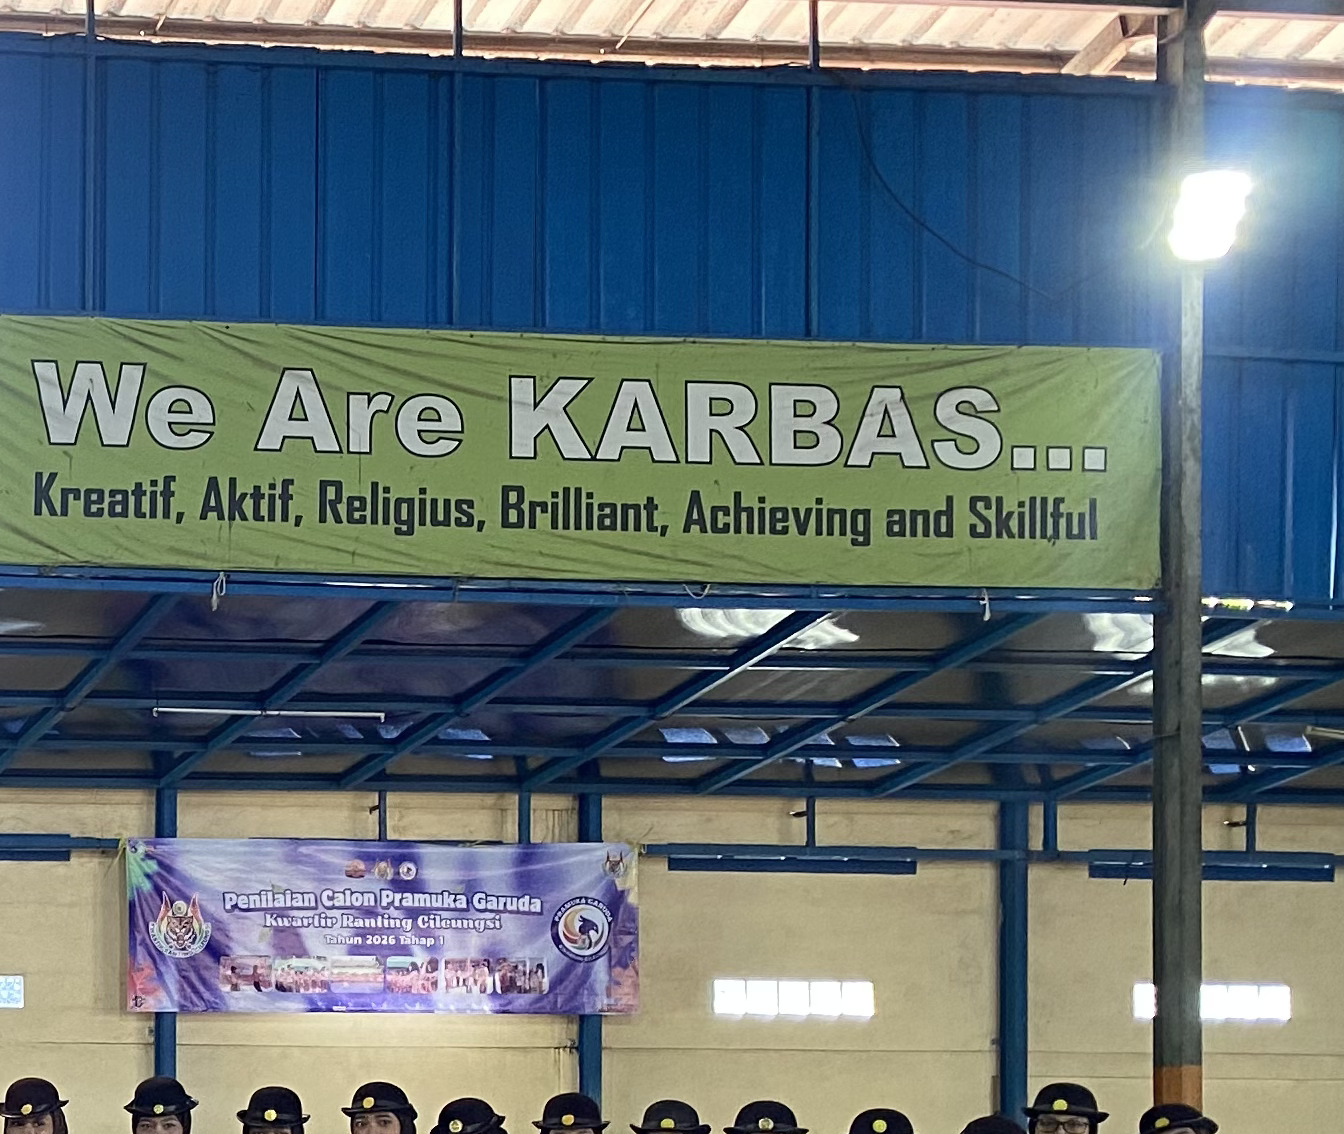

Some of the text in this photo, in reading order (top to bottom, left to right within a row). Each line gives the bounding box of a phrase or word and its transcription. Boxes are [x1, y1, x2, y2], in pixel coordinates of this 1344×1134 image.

[31, 358, 1108, 472] We Are KARBAS...
[33, 471, 1099, 548] Kreatif, Aktif, Religius, Brilliant, Achieving and Skillful
[222, 889, 542, 914] Penilaian Calon Pramuka Garuda
[588, 899, 613, 922] GARUDA
[264, 913, 501, 932] Kwartir Ranting Cileungsi
[324, 934, 362, 947] Tahun
[366, 934, 396, 947] 2026
[399, 934, 435, 950] Tahap
